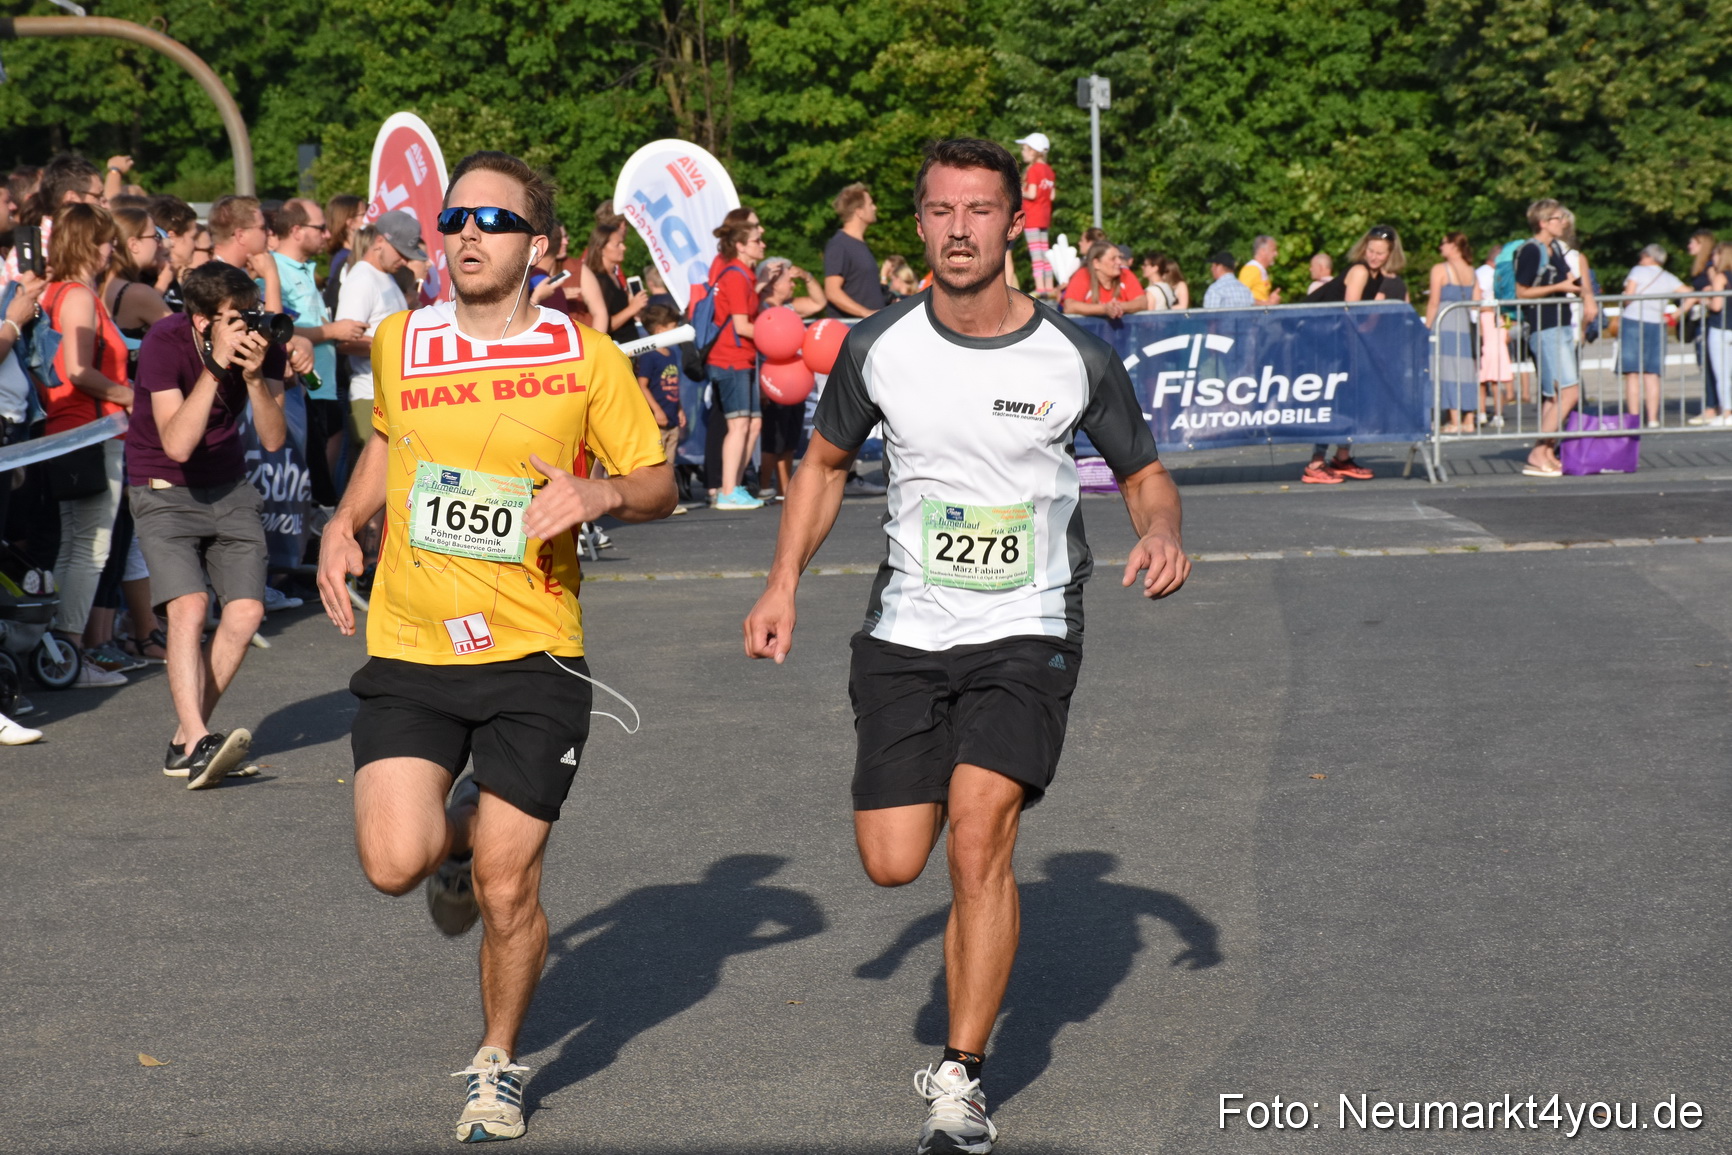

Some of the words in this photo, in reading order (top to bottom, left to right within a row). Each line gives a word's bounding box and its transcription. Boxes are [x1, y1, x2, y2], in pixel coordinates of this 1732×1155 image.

[400, 382, 480, 411] MAX
[492, 372, 586, 401] BÖGL
[1152, 365, 1349, 408] Fischer
[993, 399, 1036, 415] swn
[1170, 407, 1332, 430] AUTOMOBILE
[501, 500, 524, 508] 2019
[426, 496, 512, 538] 1650
[430, 528, 462, 541] Pöhner
[464, 534, 501, 546] Dominik
[1007, 524, 1027, 534] 2019
[424, 536, 435, 544] Max
[437, 538, 451, 547] Bögl
[452, 541, 485, 551] Bauservice
[935, 532, 1020, 565] 2278
[952, 565, 972, 573] März
[974, 566, 1005, 575] Fabian
